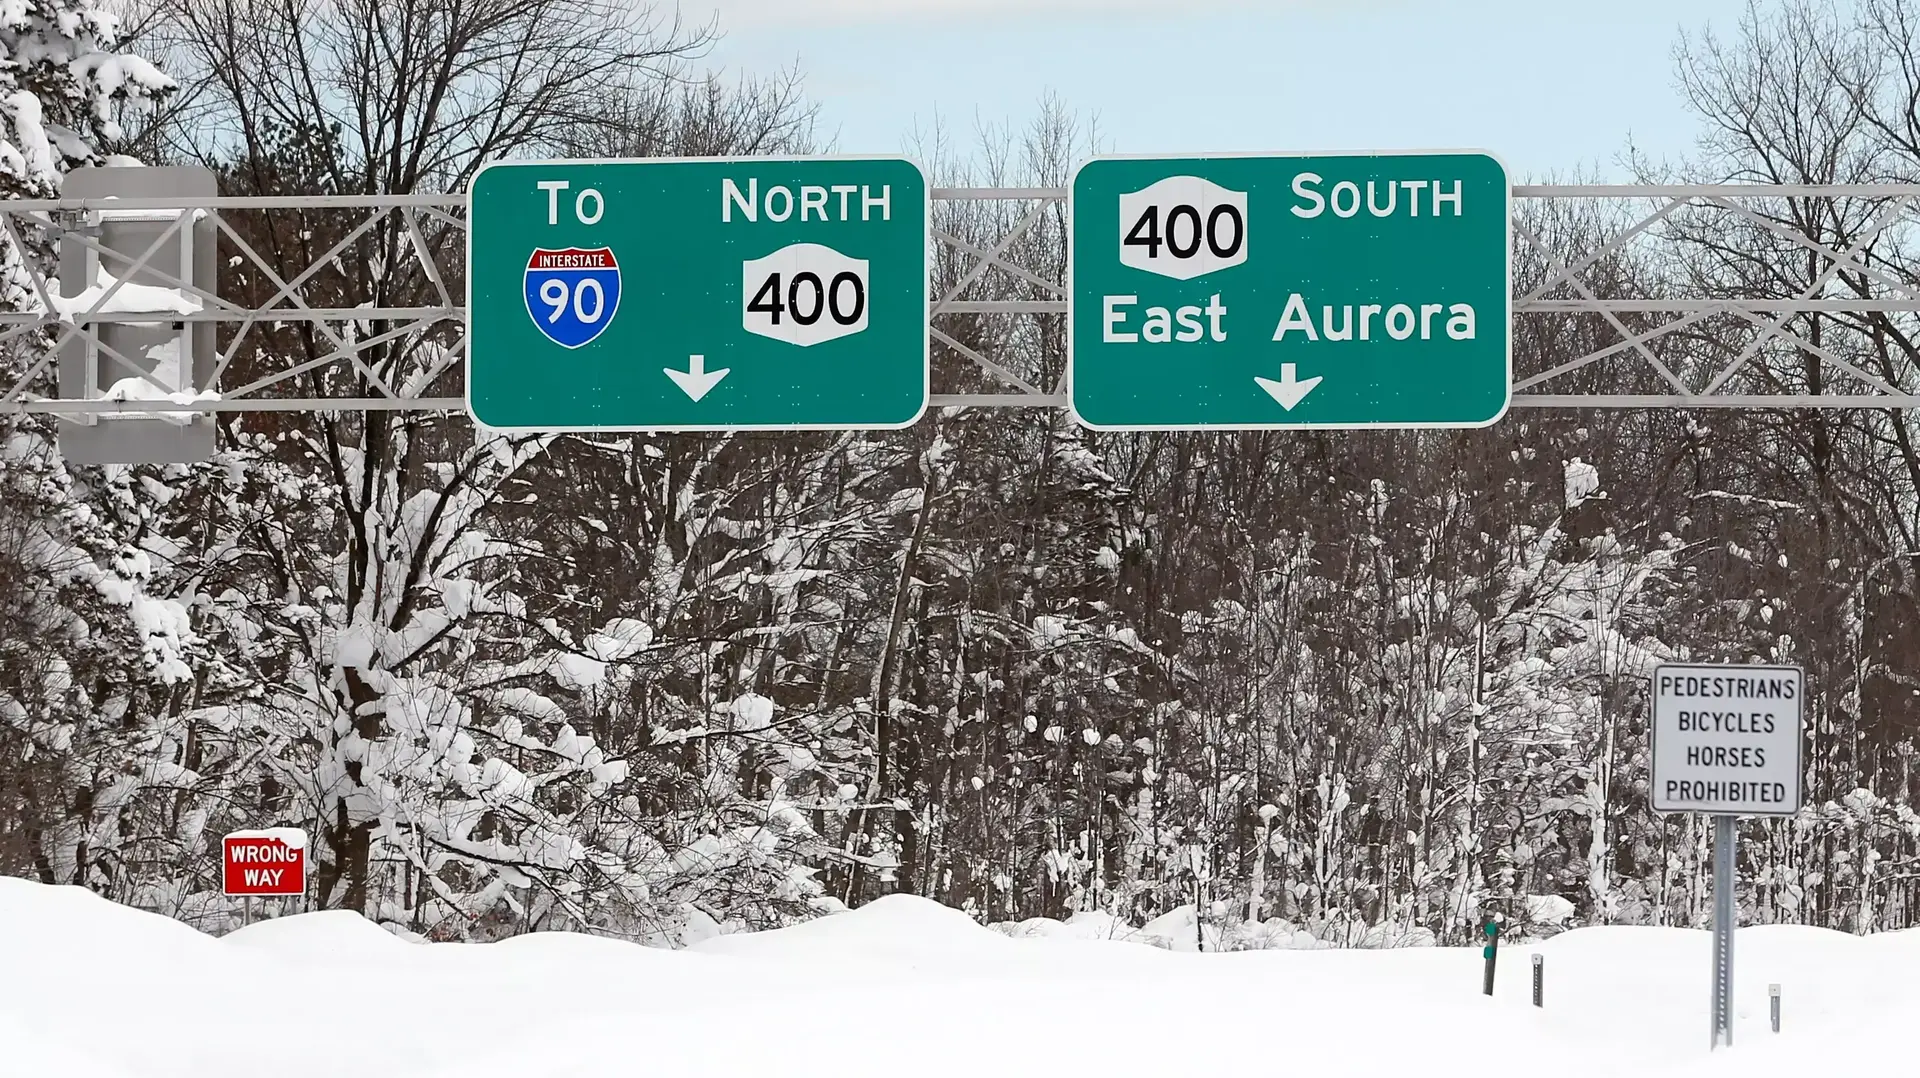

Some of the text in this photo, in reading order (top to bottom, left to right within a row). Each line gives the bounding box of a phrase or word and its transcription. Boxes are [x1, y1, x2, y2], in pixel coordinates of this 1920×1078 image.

[722, 178, 891, 222] NORTH
[1290, 172, 1462, 218] SOUTH
[1123, 204, 1244, 259] 400
[539, 253, 605, 268] INTERSTATE
[539, 278, 605, 324] 90
[746, 271, 865, 326] 400
[1103, 293, 1476, 343] East Aurora
[1661, 676, 1795, 699] PEDESTRIANS
[1679, 711, 1775, 733] BICYCLES
[1687, 746, 1765, 767] HORSES
[1666, 780, 1785, 802] PROHIBITED
[230, 845, 298, 863] WRONG
[244, 869, 284, 886] WAY
